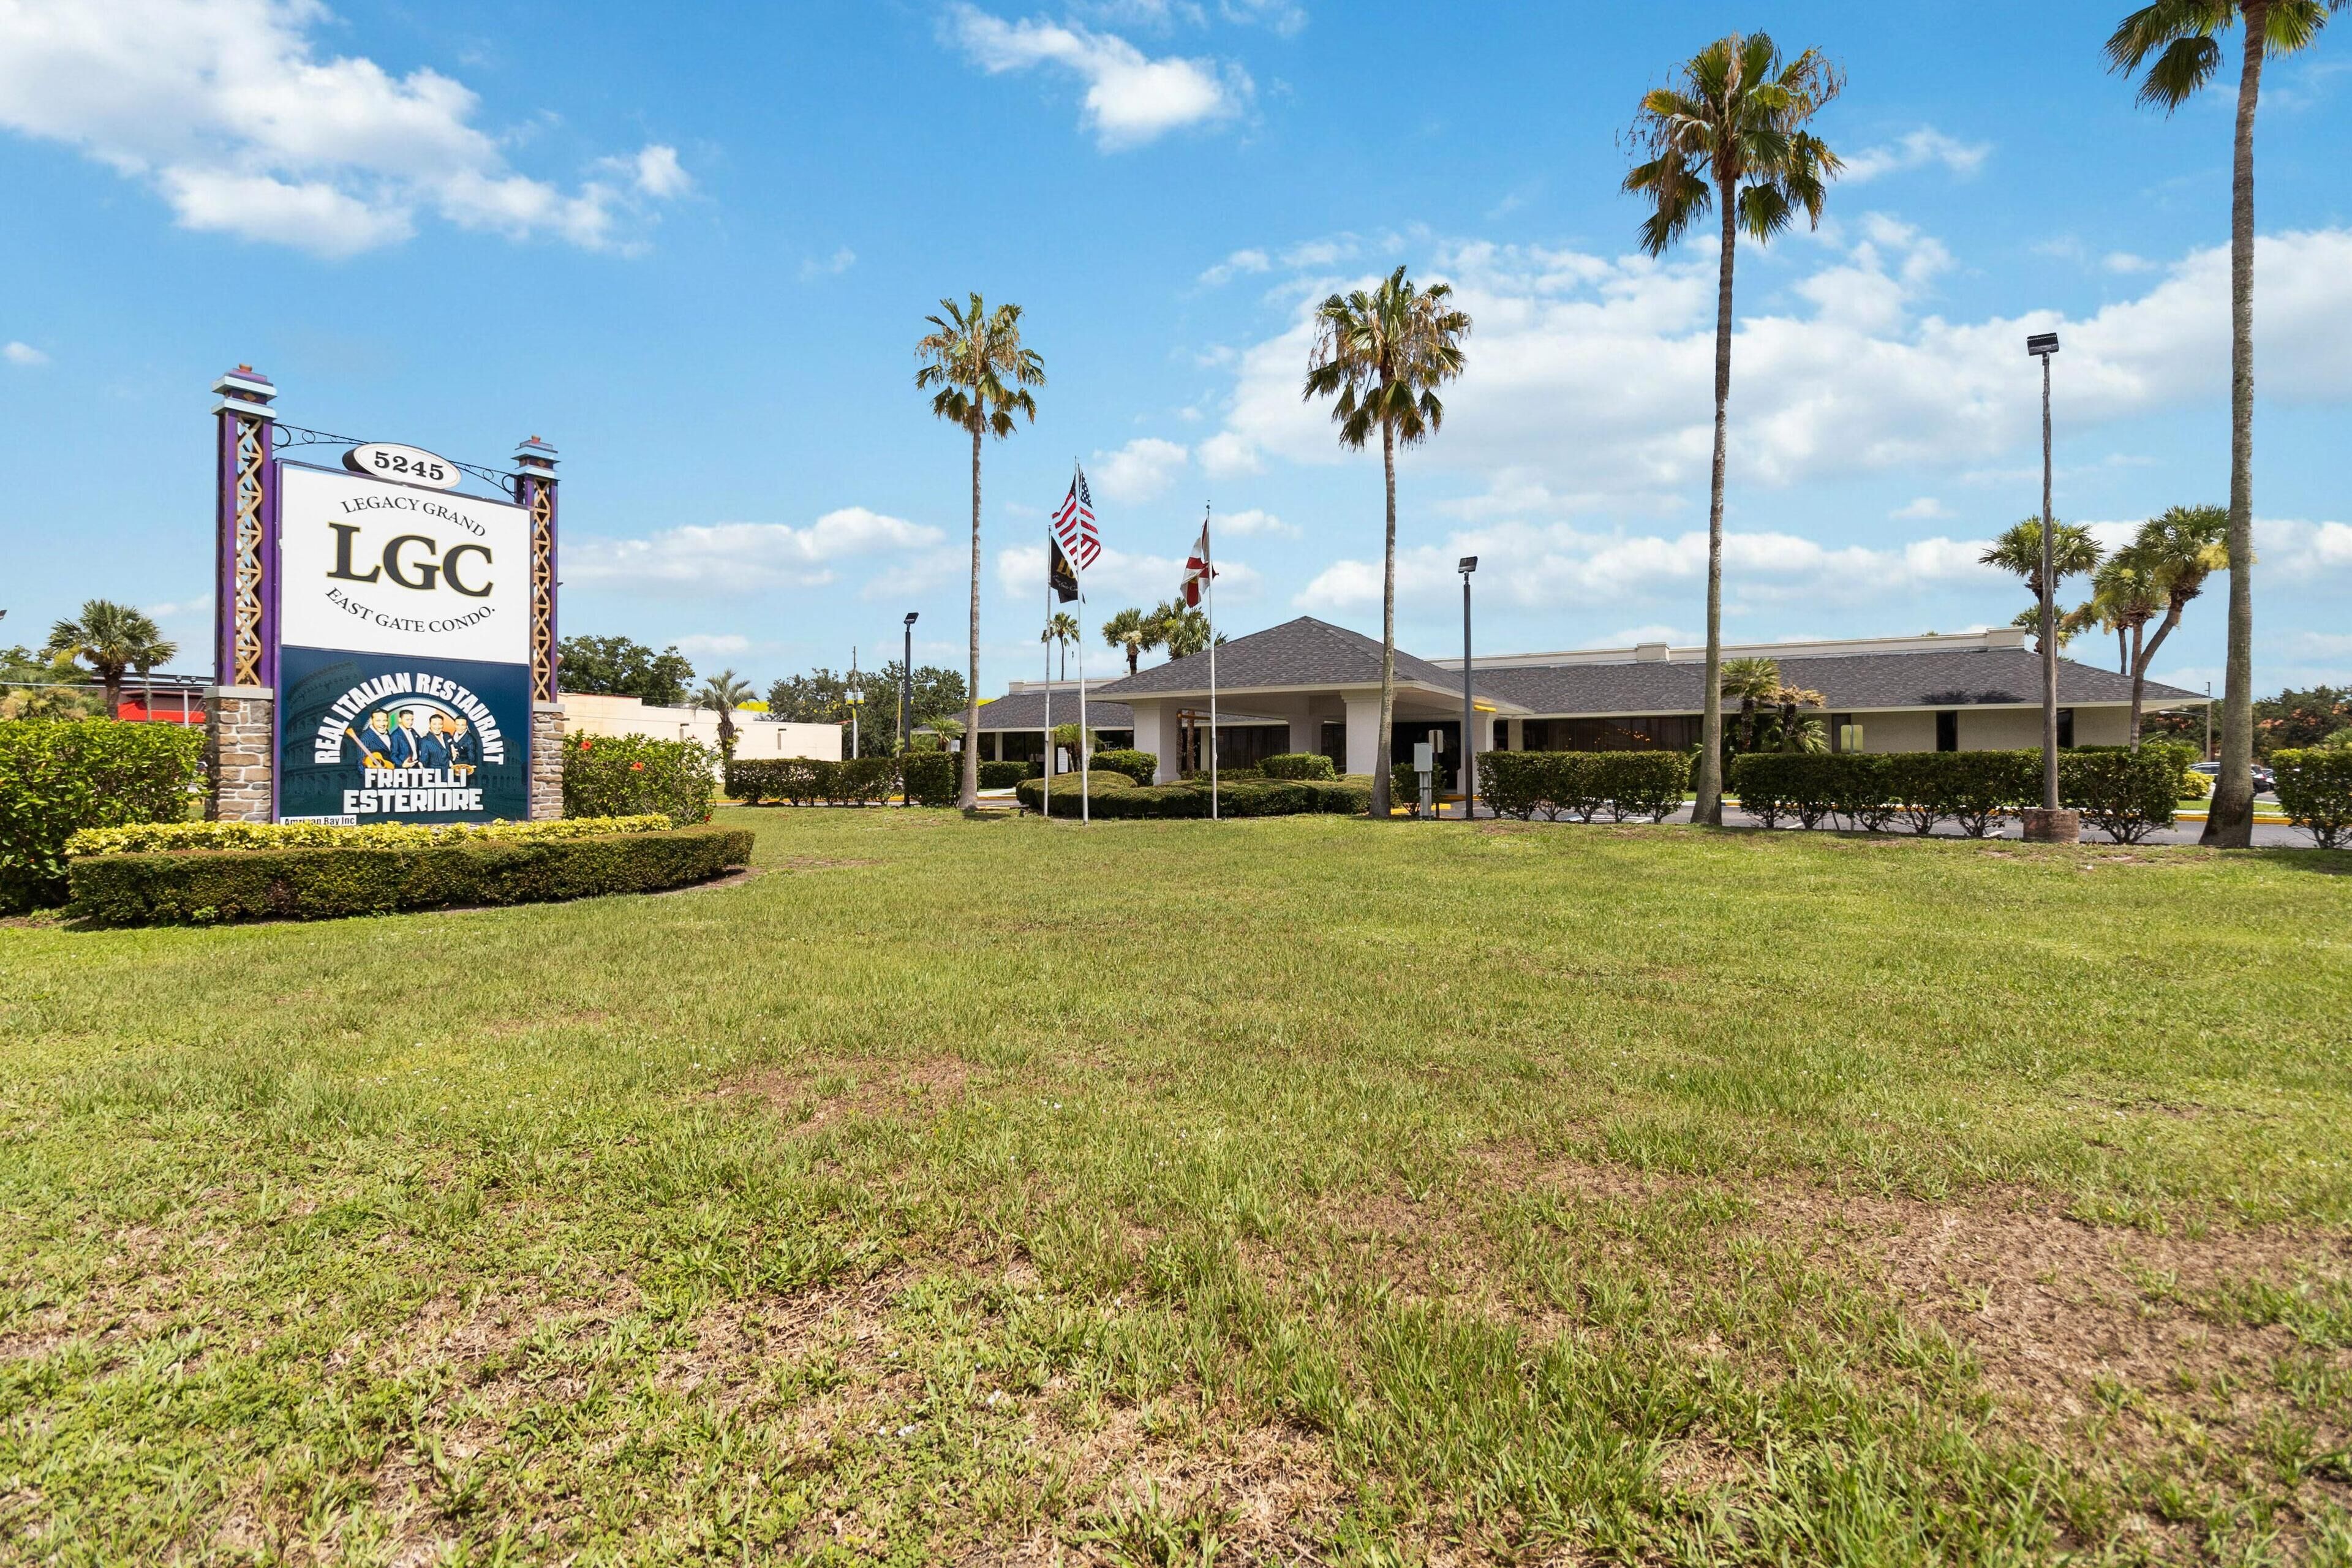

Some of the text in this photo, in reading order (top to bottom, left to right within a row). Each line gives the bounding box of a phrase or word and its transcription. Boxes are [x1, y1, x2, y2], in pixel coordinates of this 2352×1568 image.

[374, 451, 444, 480] 5245
[341, 496, 485, 537] LEGACY GRAND
[326, 521, 494, 597] LGC
[325, 587, 495, 633] EAST GATE CONDO.
[314, 673, 504, 765] REAL ITALIAN RESTAURANT
[364, 768, 467, 788] FRATELLI
[323, 817, 340, 826] Bay
